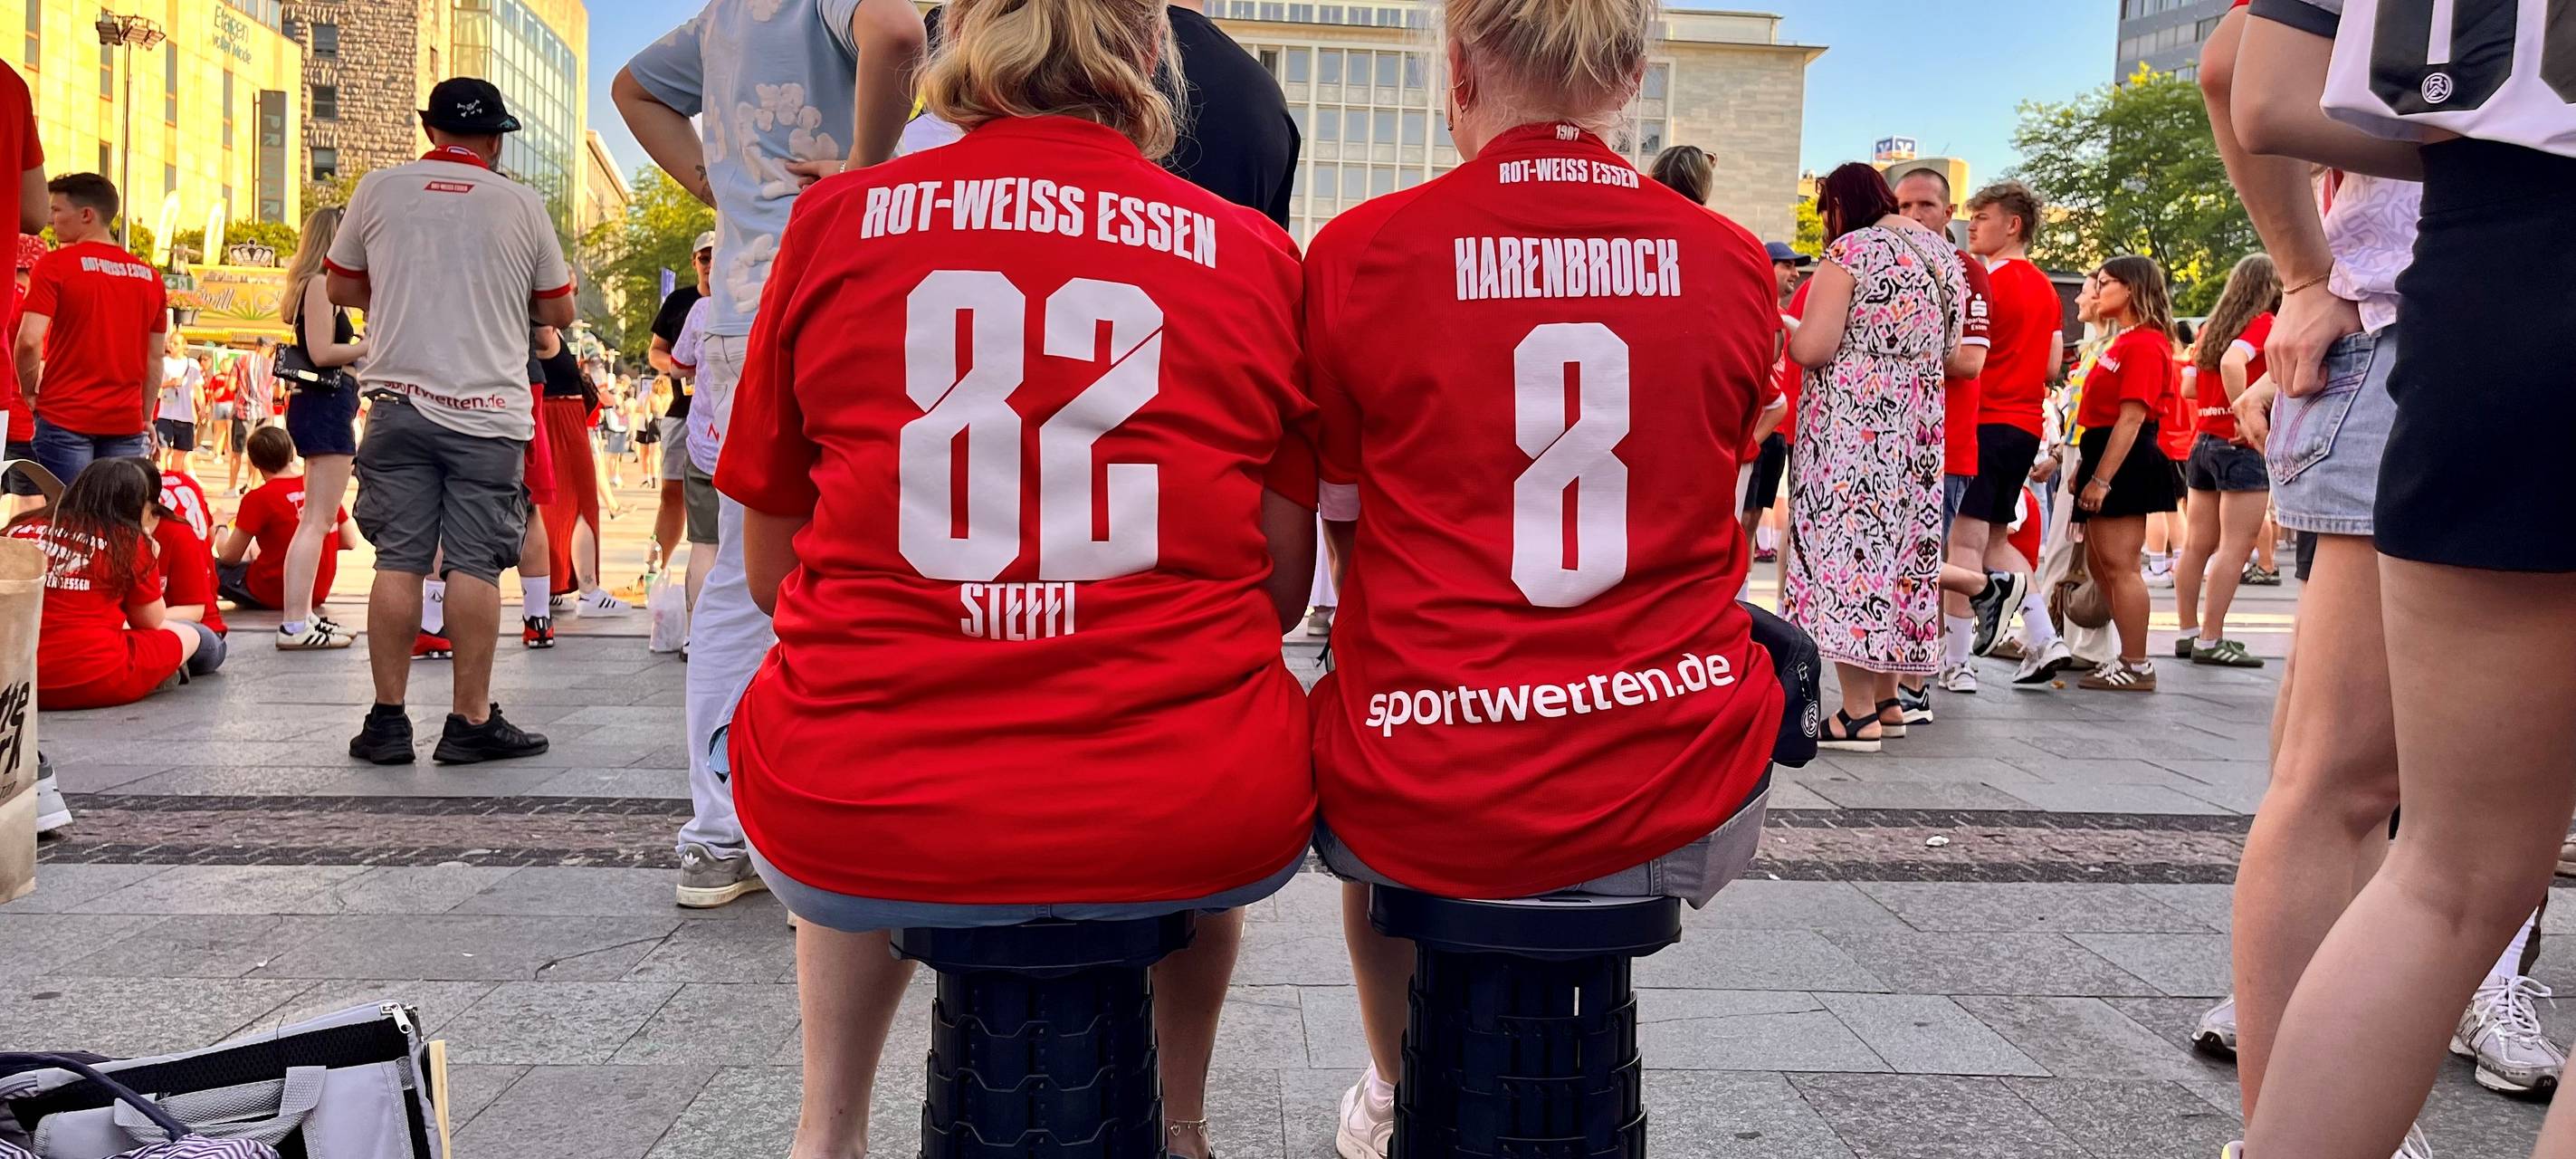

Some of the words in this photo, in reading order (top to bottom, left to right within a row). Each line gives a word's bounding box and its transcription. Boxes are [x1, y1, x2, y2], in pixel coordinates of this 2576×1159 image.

[214, 5, 249, 43] Etagen
[1555, 124, 1580, 141] 1907
[262, 114, 281, 225] PRIMAR
[1499, 158, 1589, 184] ROT-WEISS
[1591, 160, 1639, 189] ESSEN
[861, 177, 1084, 240] ROT-WEISS
[1097, 190, 1216, 269] ESSEN
[1455, 236, 1681, 301] HARENBROCK
[384, 380, 506, 410] sportwetten.de
[898, 269, 1164, 582] 82
[1511, 322, 1630, 608] 8
[960, 581, 1075, 641] STEFFI
[1365, 653, 1735, 738] sportwetten.de
